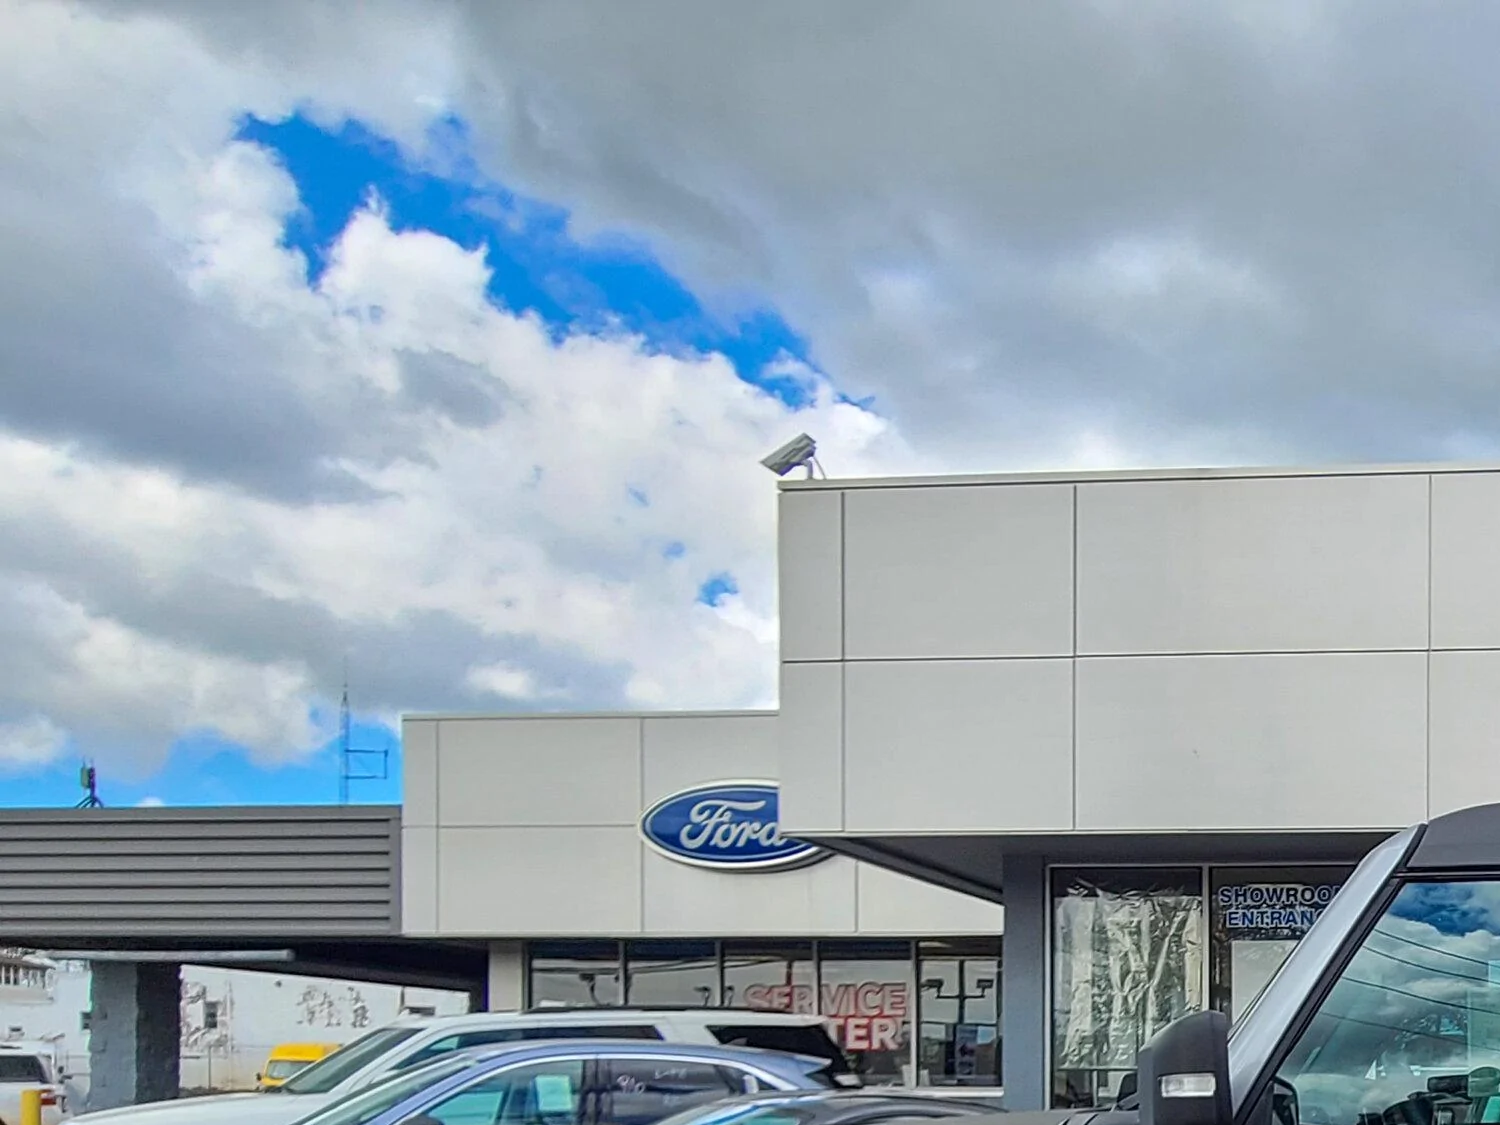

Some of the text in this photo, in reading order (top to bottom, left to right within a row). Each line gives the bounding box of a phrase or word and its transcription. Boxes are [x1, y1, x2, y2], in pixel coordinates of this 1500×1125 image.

[1219, 886, 1342, 905] SHOWROO
[1227, 909, 1326, 928] ENTRAN
[744, 982, 907, 1017] SERVICE
[826, 1015, 901, 1051] TER
